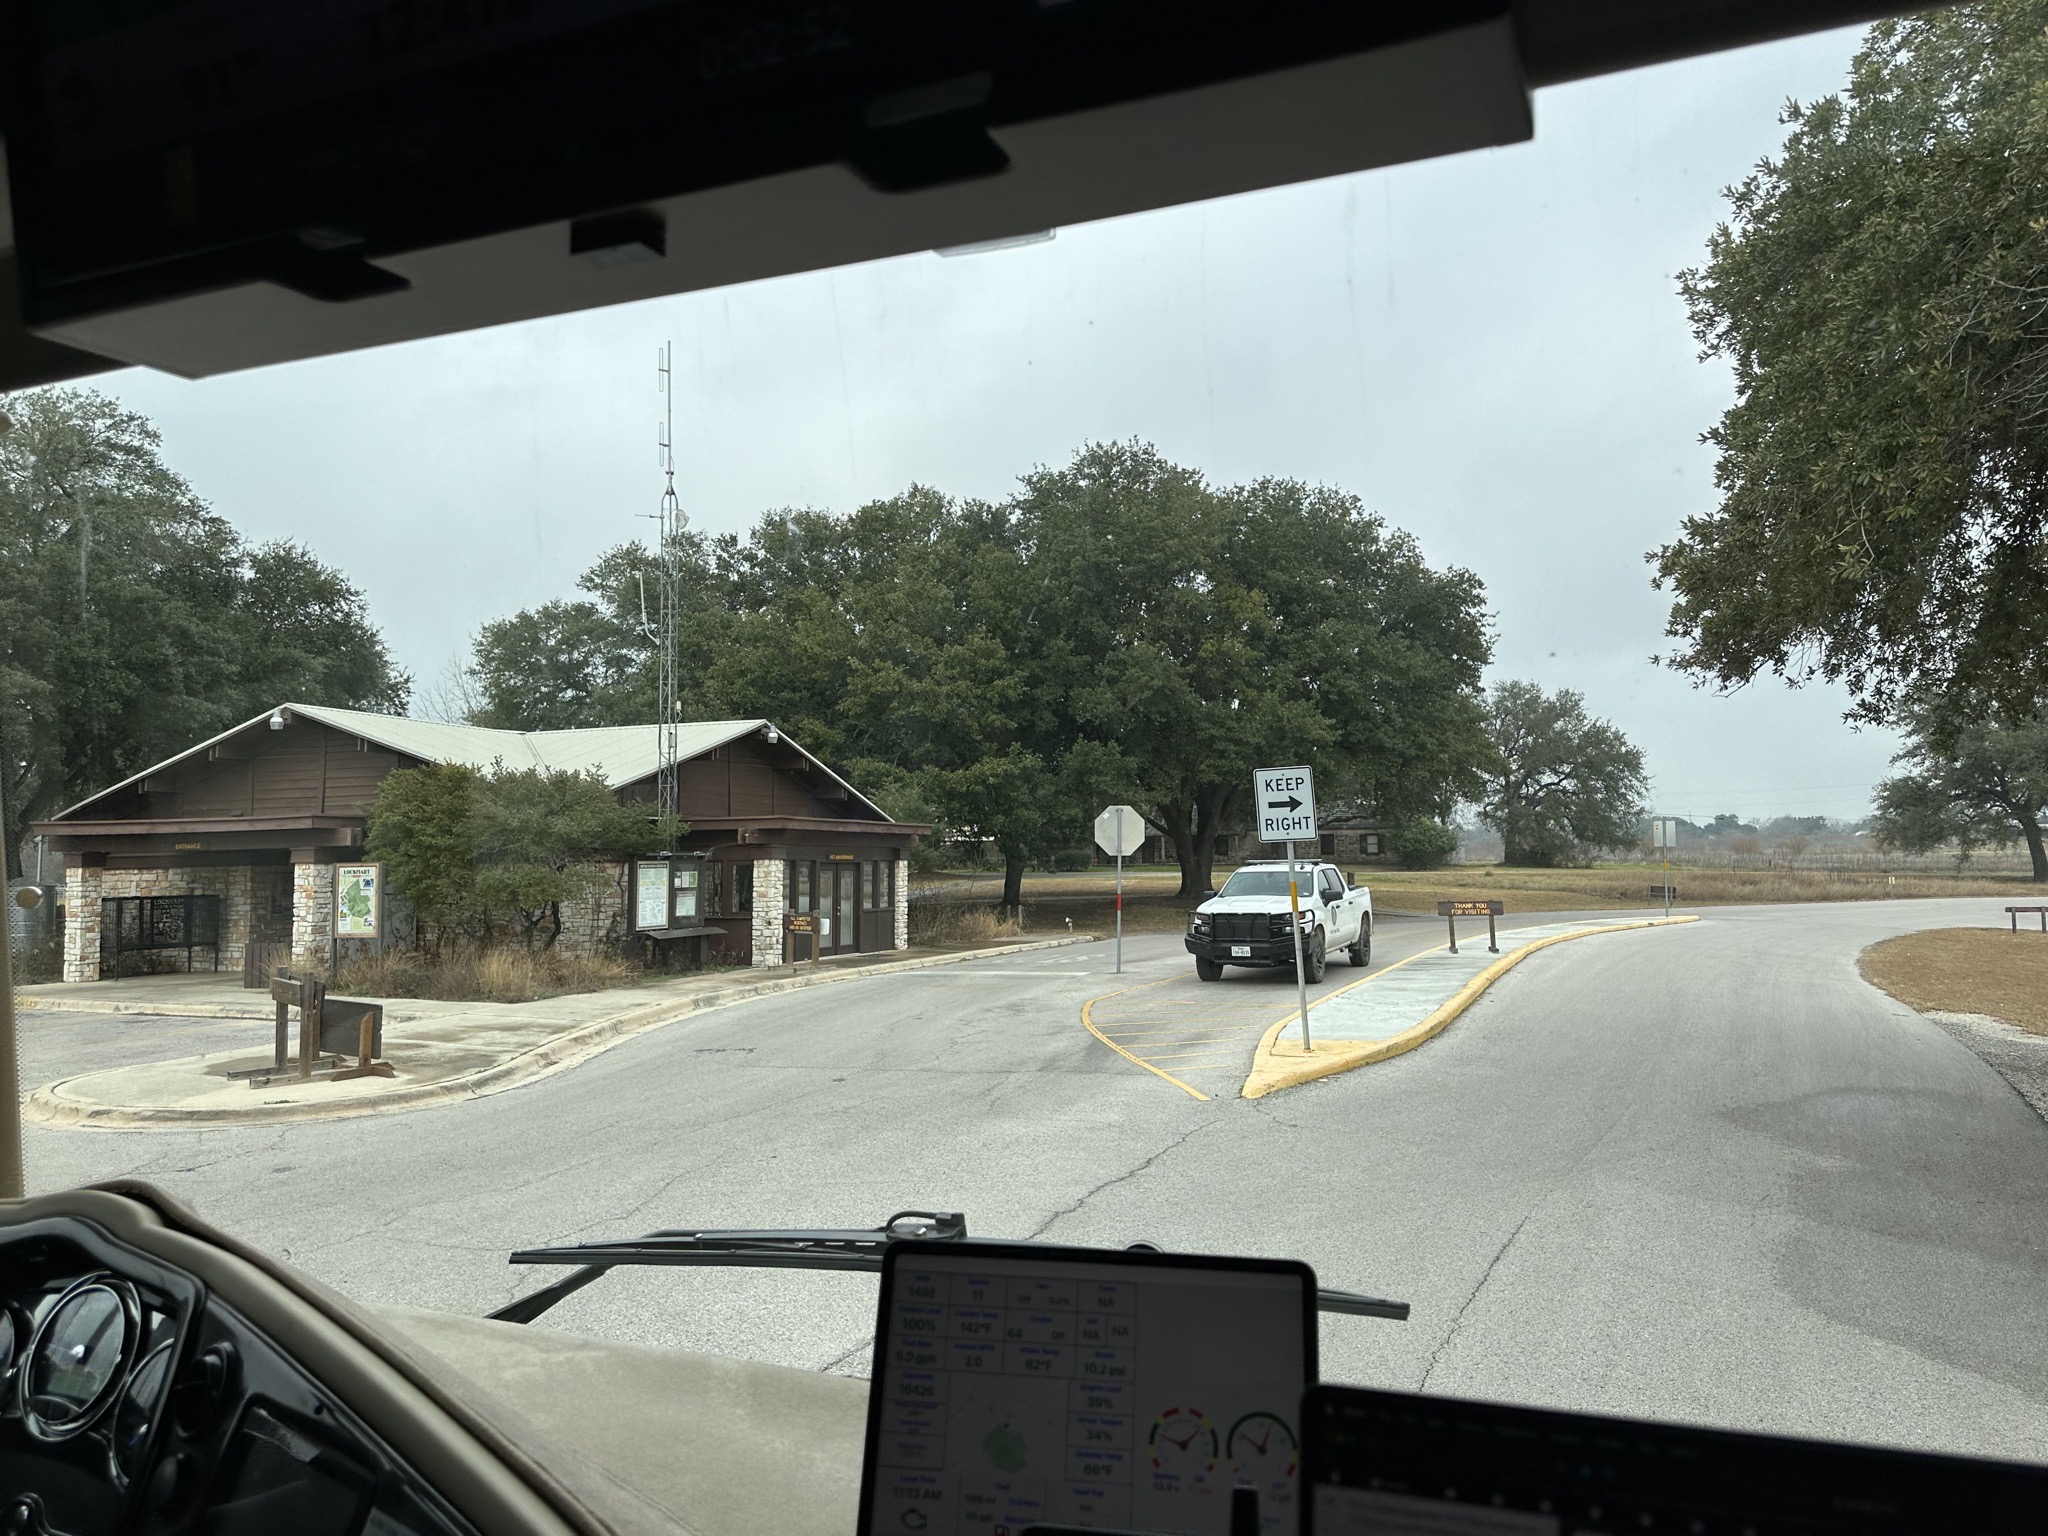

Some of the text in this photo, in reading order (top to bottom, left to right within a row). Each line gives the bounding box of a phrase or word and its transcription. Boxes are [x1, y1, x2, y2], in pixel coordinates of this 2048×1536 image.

[1265, 777, 1304, 792] KEEP
[1265, 816, 1311, 832] RIGHT
[1098, 1296, 1115, 1308] NA
[900, 1318, 937, 1331] 100%
[960, 1321, 993, 1334] 142°F
[1112, 1325, 1129, 1337] NA
[1082, 1329, 1100, 1340] NA
[1084, 1362, 1108, 1376] 10.2
[922, 1488, 942, 1501] AM
